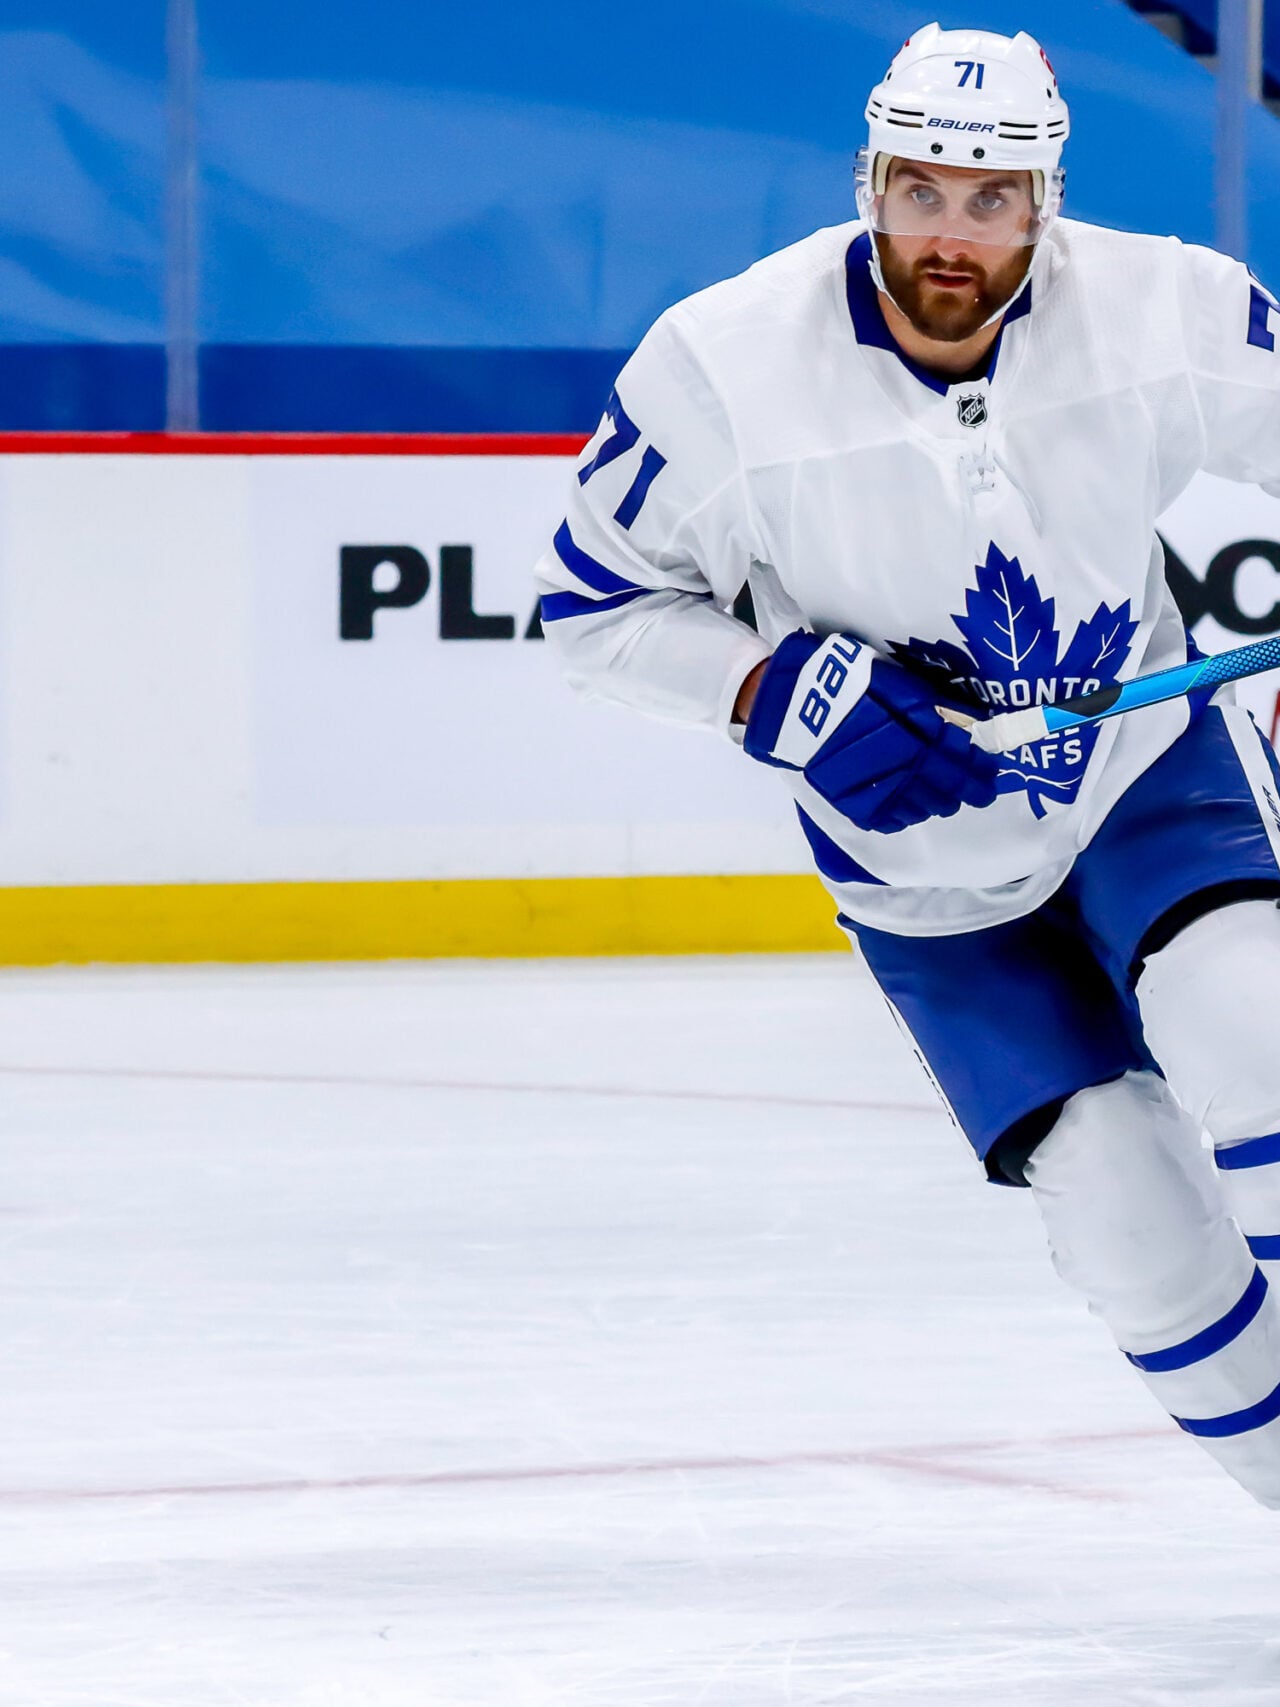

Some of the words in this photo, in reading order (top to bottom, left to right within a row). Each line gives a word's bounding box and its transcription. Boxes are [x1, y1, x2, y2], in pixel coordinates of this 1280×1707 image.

[954, 61, 985, 90] 71
[926, 117, 996, 134] BAUER
[577, 387, 668, 532] 71
[339, 544, 545, 641] PL
